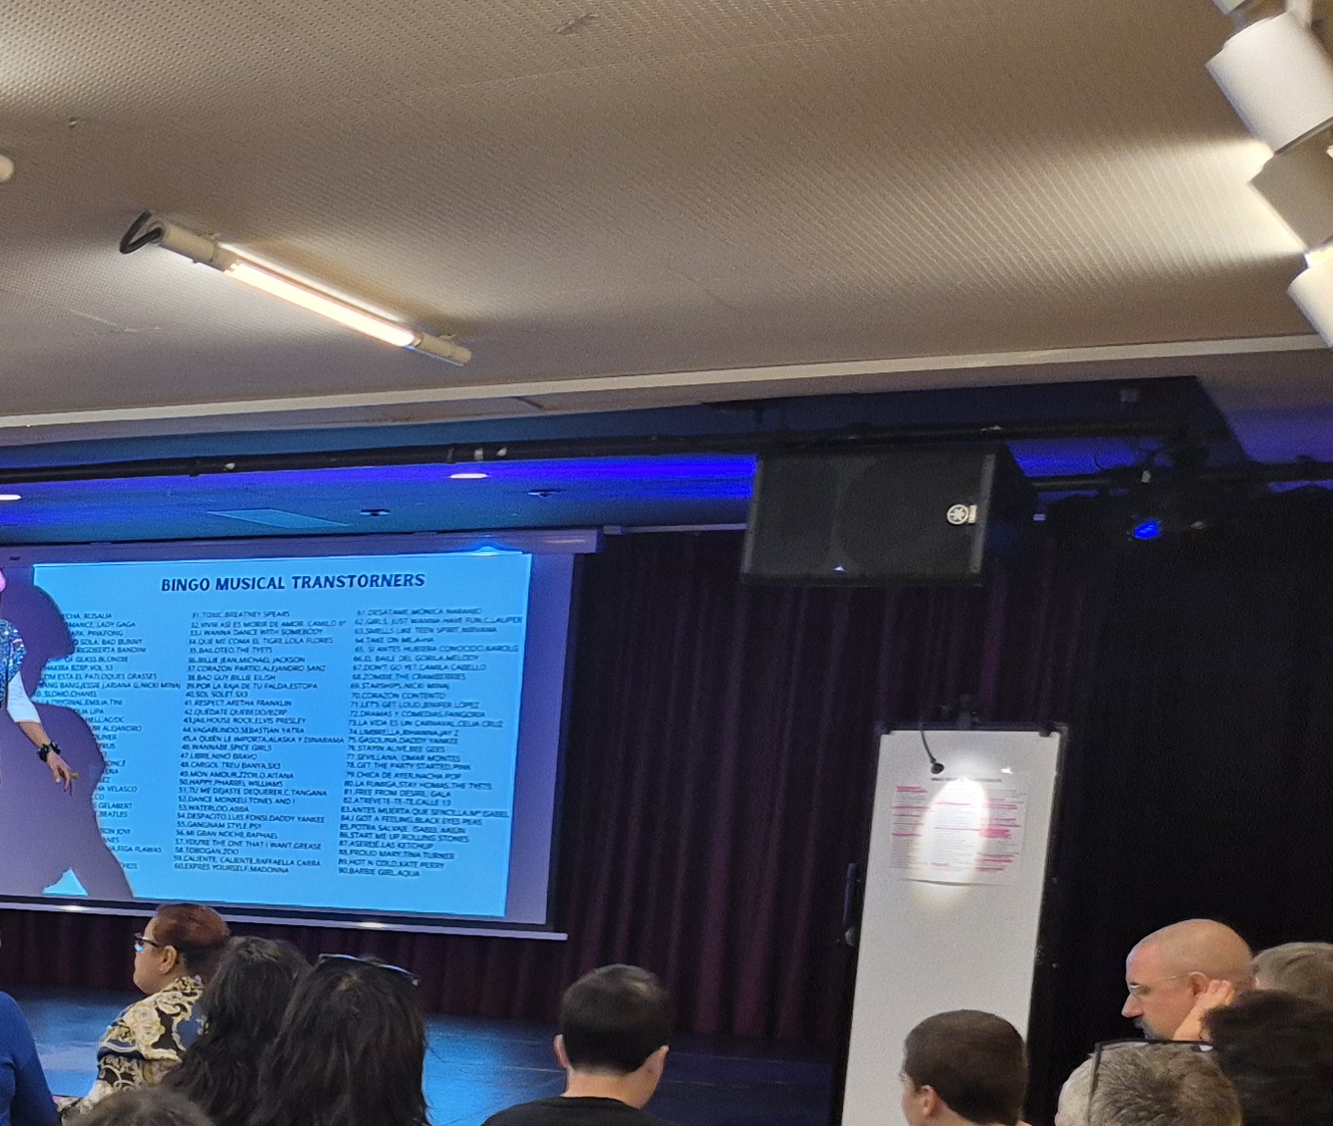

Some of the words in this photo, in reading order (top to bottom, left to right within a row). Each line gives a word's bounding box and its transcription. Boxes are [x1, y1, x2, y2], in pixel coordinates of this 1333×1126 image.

[161, 578, 210, 591] BINGO
[215, 576, 286, 590] MUSICAL
[292, 573, 426, 589] TRANSTORNERS
